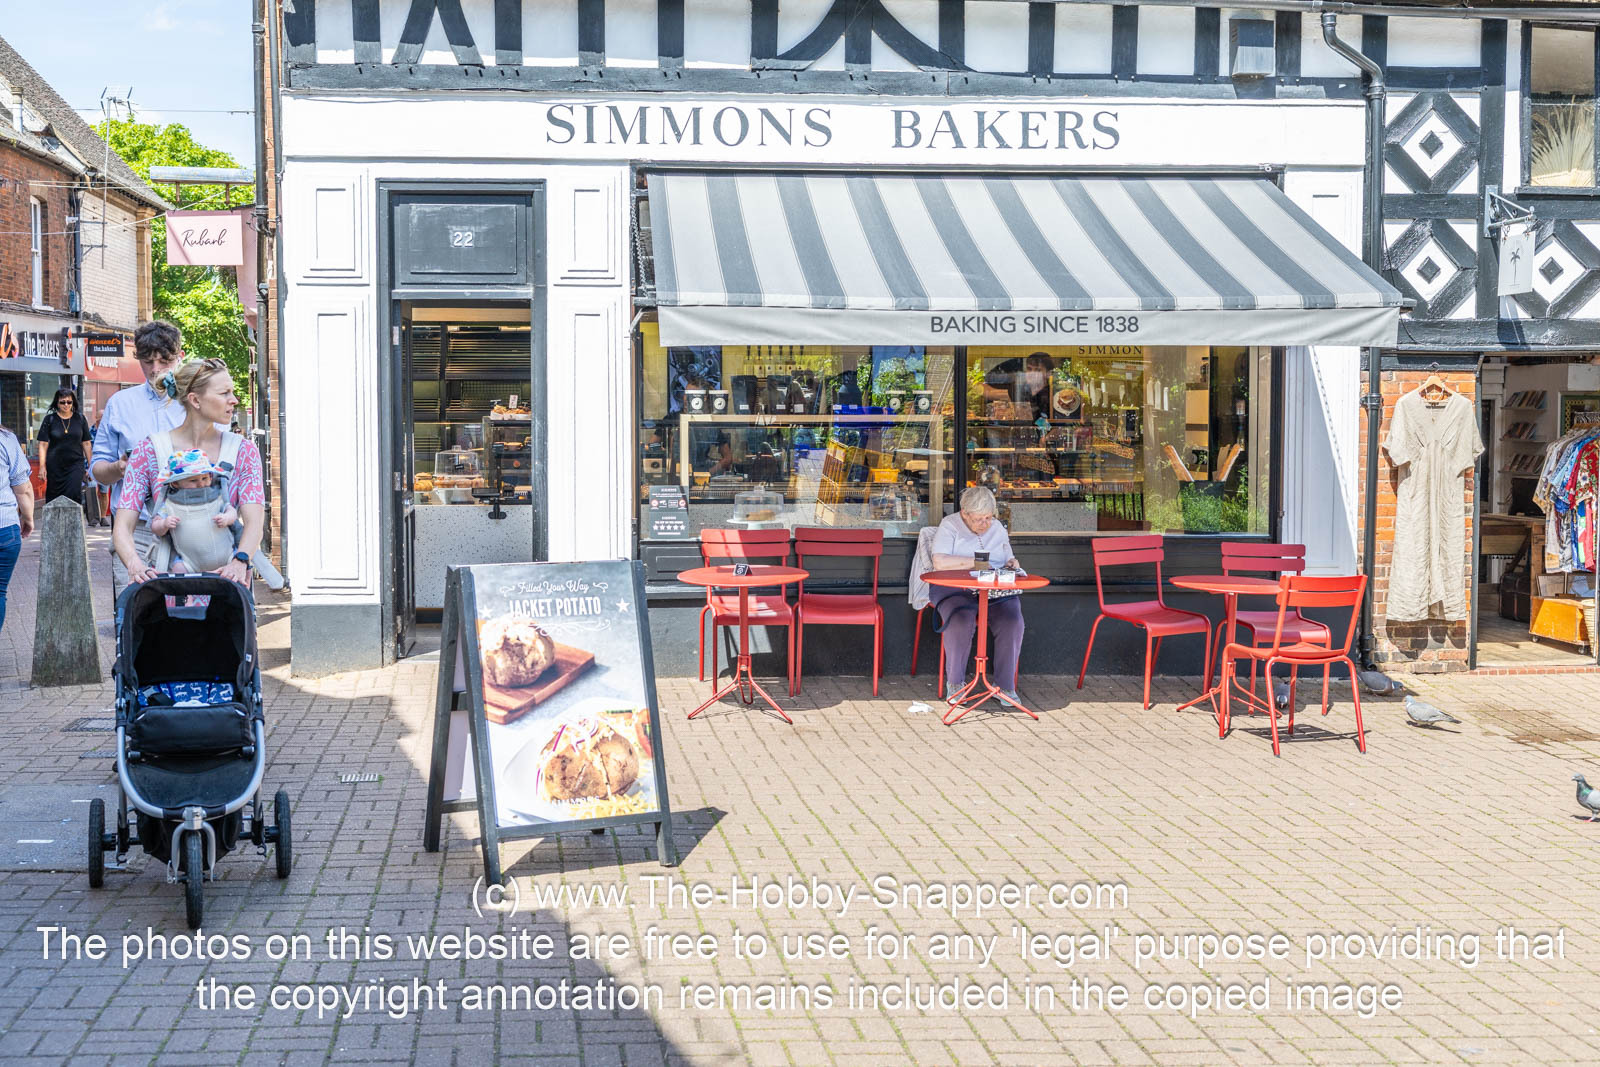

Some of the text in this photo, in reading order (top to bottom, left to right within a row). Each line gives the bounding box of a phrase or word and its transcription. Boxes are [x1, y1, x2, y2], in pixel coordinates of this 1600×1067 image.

[546, 104, 1120, 150] SIMMONS BAKERS
[181, 228, 227, 247] Rubarb
[453, 231, 473, 247] 22
[930, 316, 1140, 333] BAKING SINCE 1838
[24, 331, 60, 358] the bakers
[1078, 346, 1143, 355] SIMMON
[517, 578, 590, 595] Filled Your Way
[508, 596, 602, 618] JACKET POTATO
